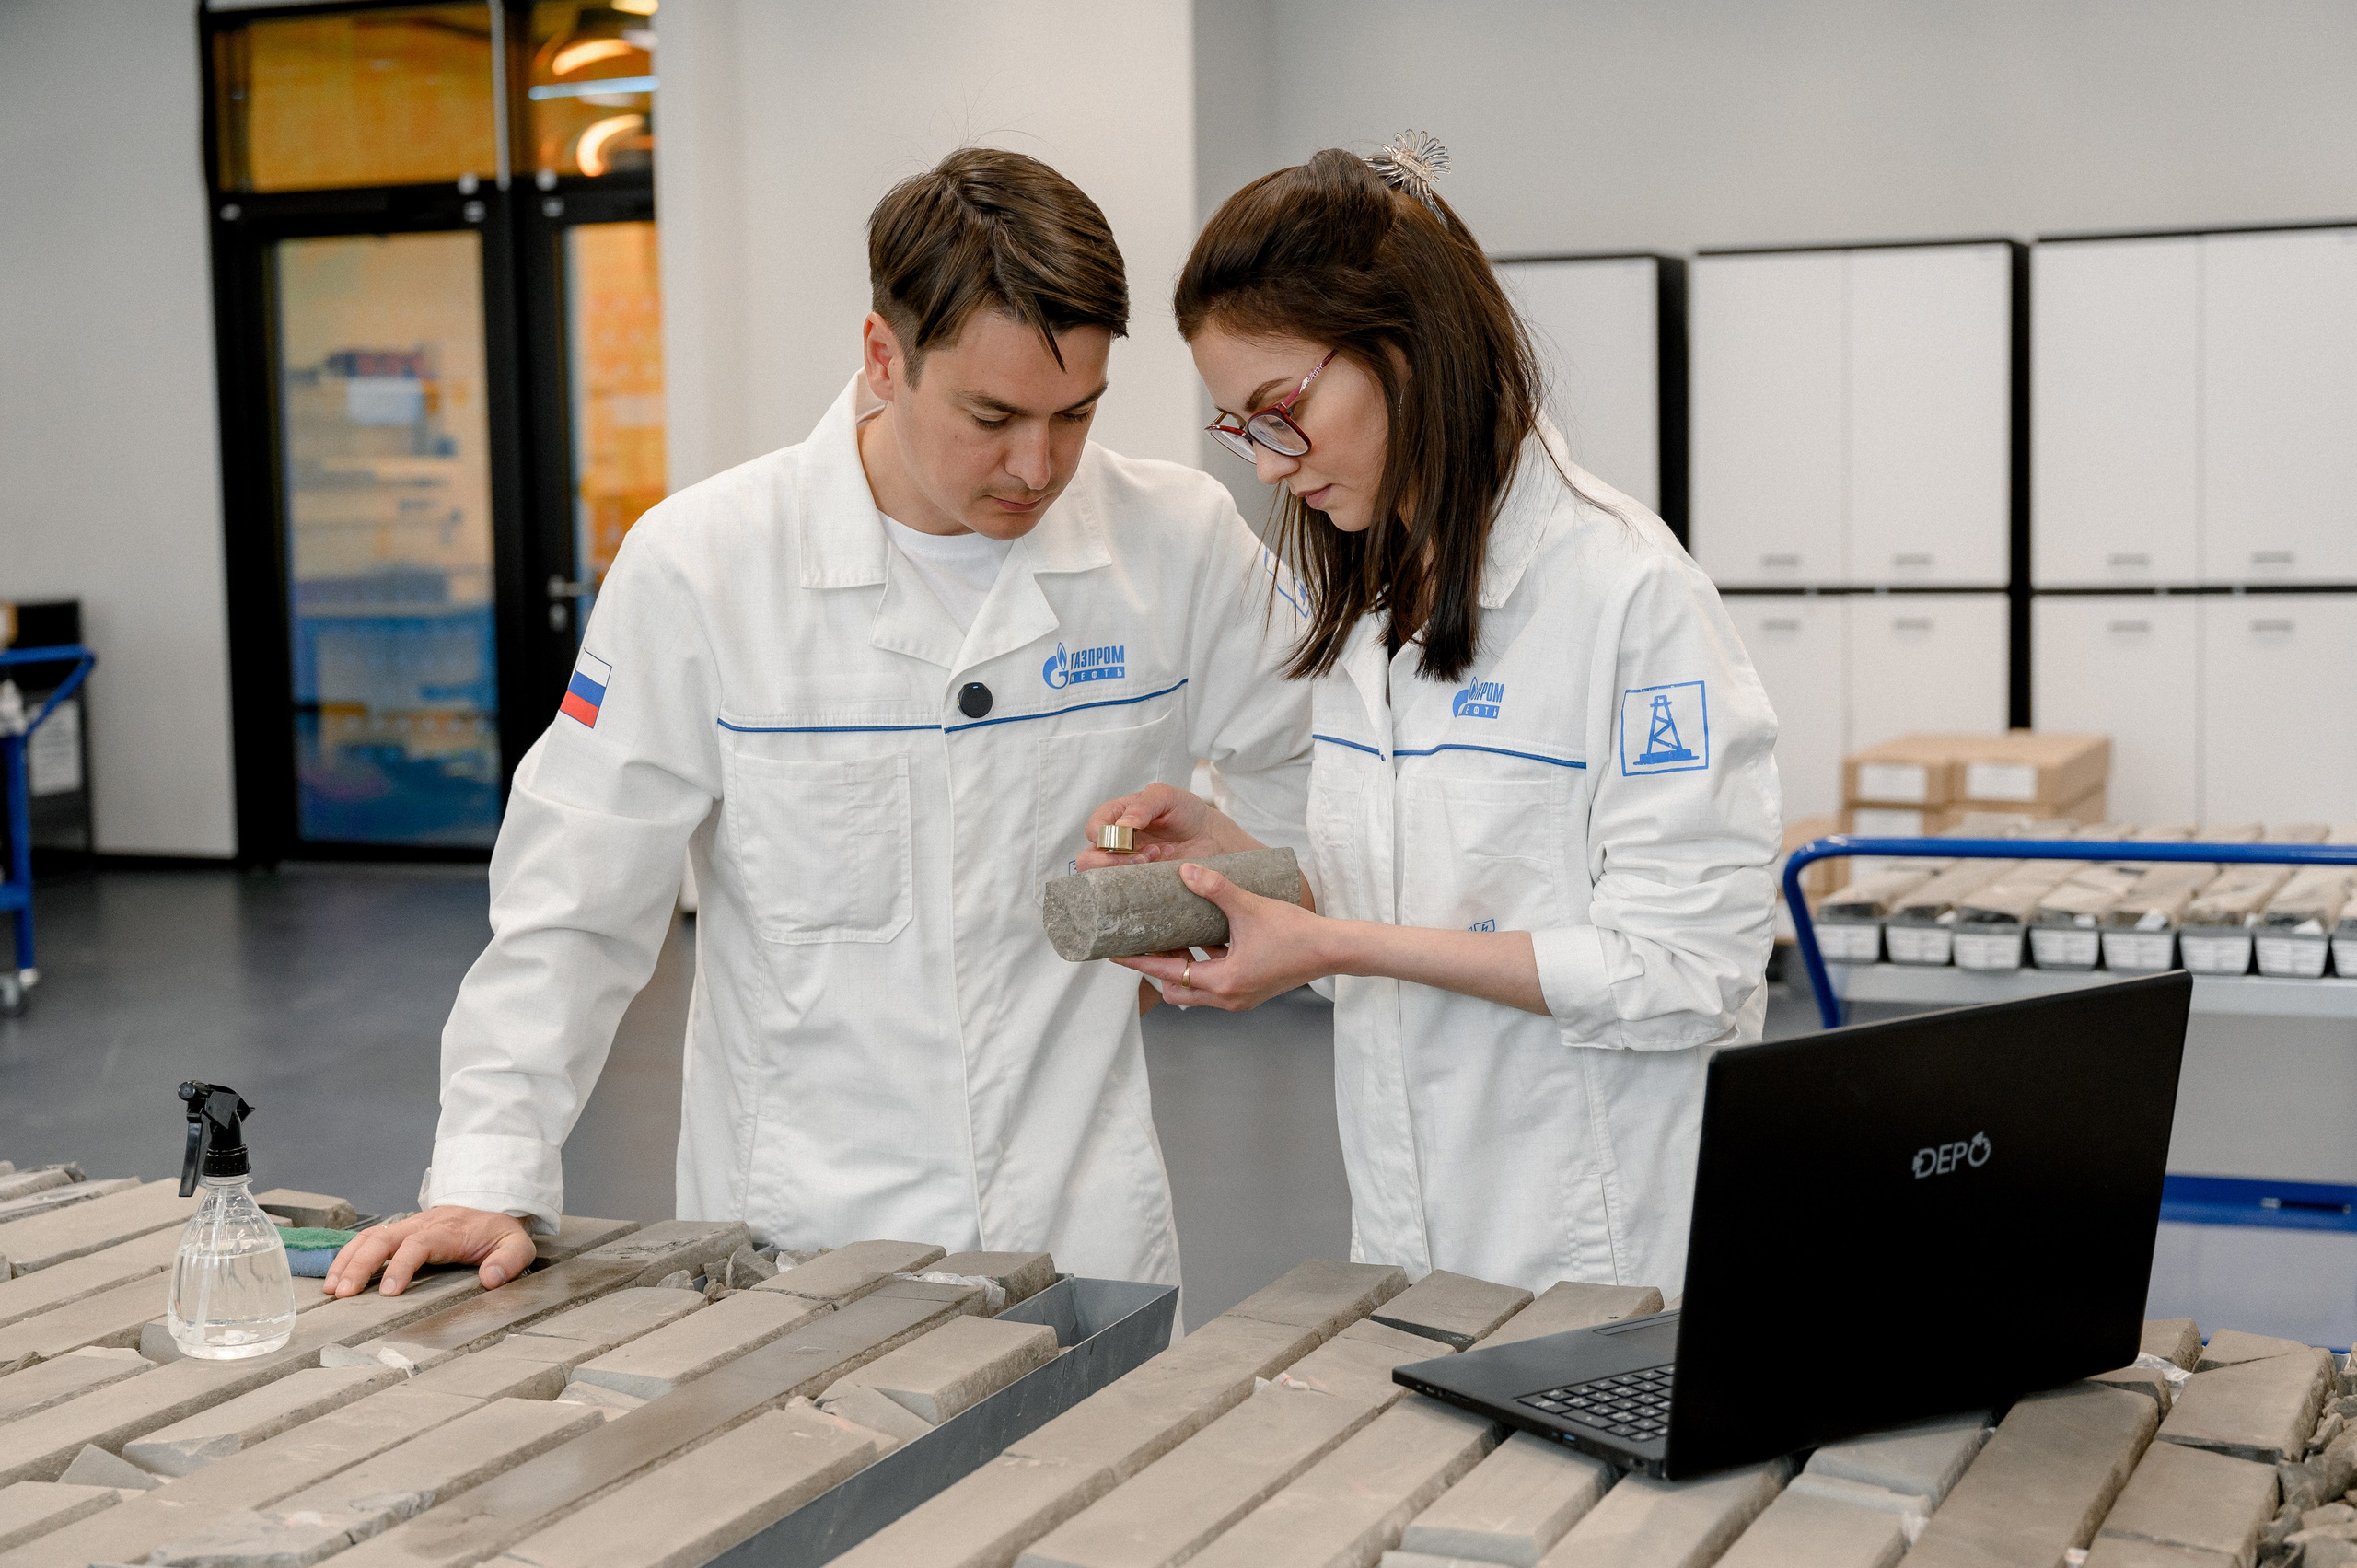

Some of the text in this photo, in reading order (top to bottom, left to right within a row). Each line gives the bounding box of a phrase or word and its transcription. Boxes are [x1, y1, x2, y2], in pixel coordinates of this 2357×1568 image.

[1071, 645, 1124, 670] ГАЗПРОМ
[1071, 668, 1122, 684] НЕФТЬ
[1465, 704, 1497, 717] ЕФТЬ
[1912, 1131, 1991, 1179] DEPO
